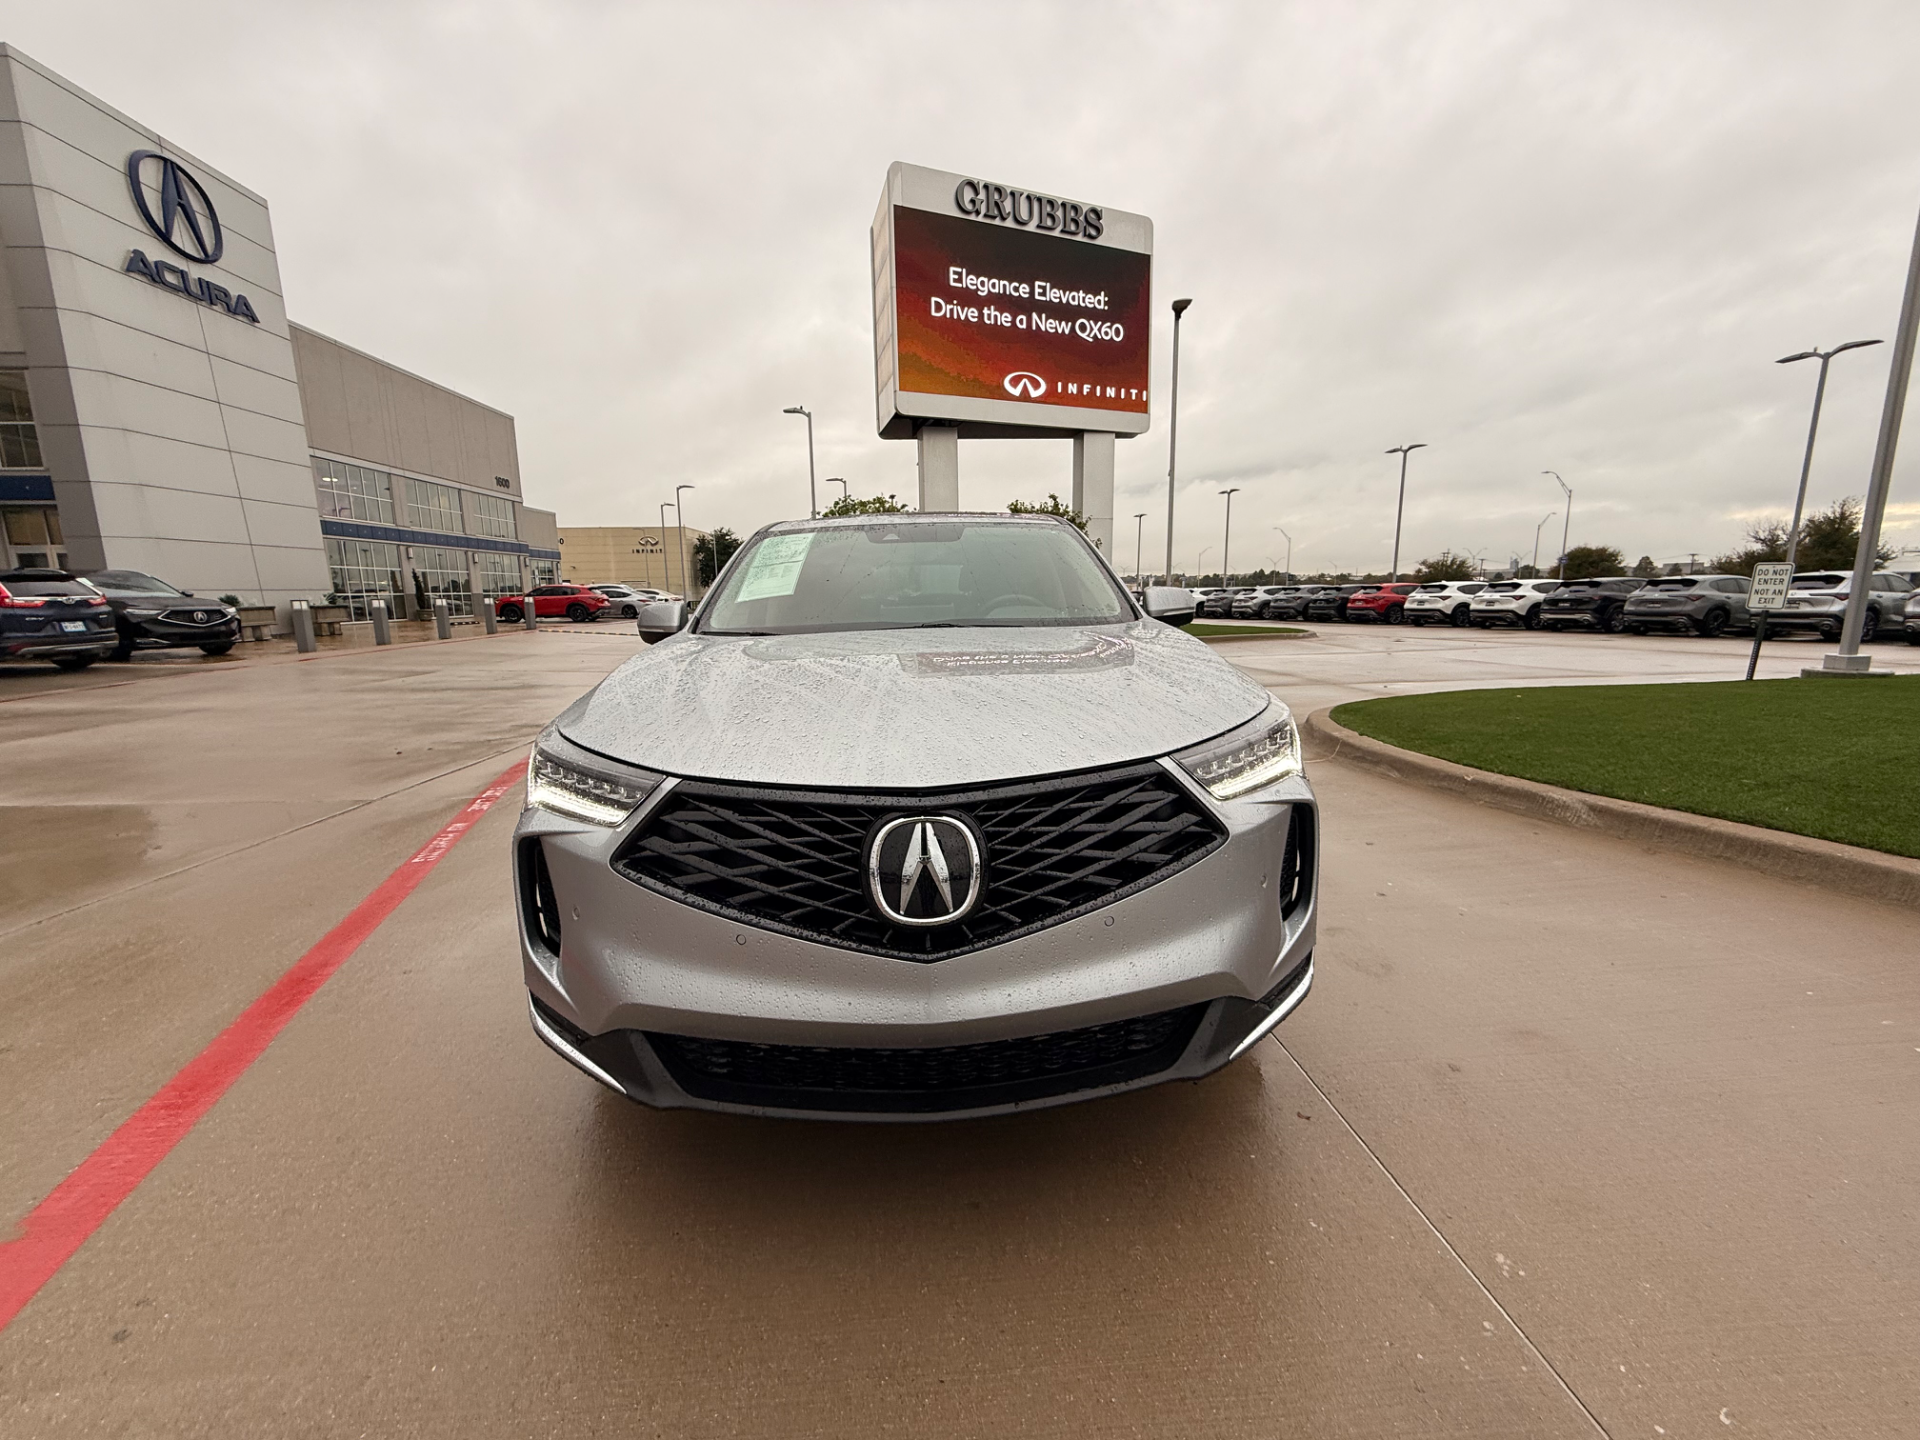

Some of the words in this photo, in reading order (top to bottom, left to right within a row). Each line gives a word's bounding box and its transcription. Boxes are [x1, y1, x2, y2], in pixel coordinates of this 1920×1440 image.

[955, 178, 1104, 239] GRUBBS
[125, 249, 260, 323] ACURA
[949, 266, 1029, 298] Elegance
[1034, 281, 1109, 310] Elevated:
[930, 296, 978, 322] Drive
[982, 305, 1012, 327] the
[1016, 314, 1027, 329] a
[1031, 312, 1072, 335] New
[1075, 318, 1124, 342] QX60
[1057, 381, 1148, 402] INFINITI
[1757, 568, 1770, 576] DO
[1772, 568, 1789, 576] NOT
